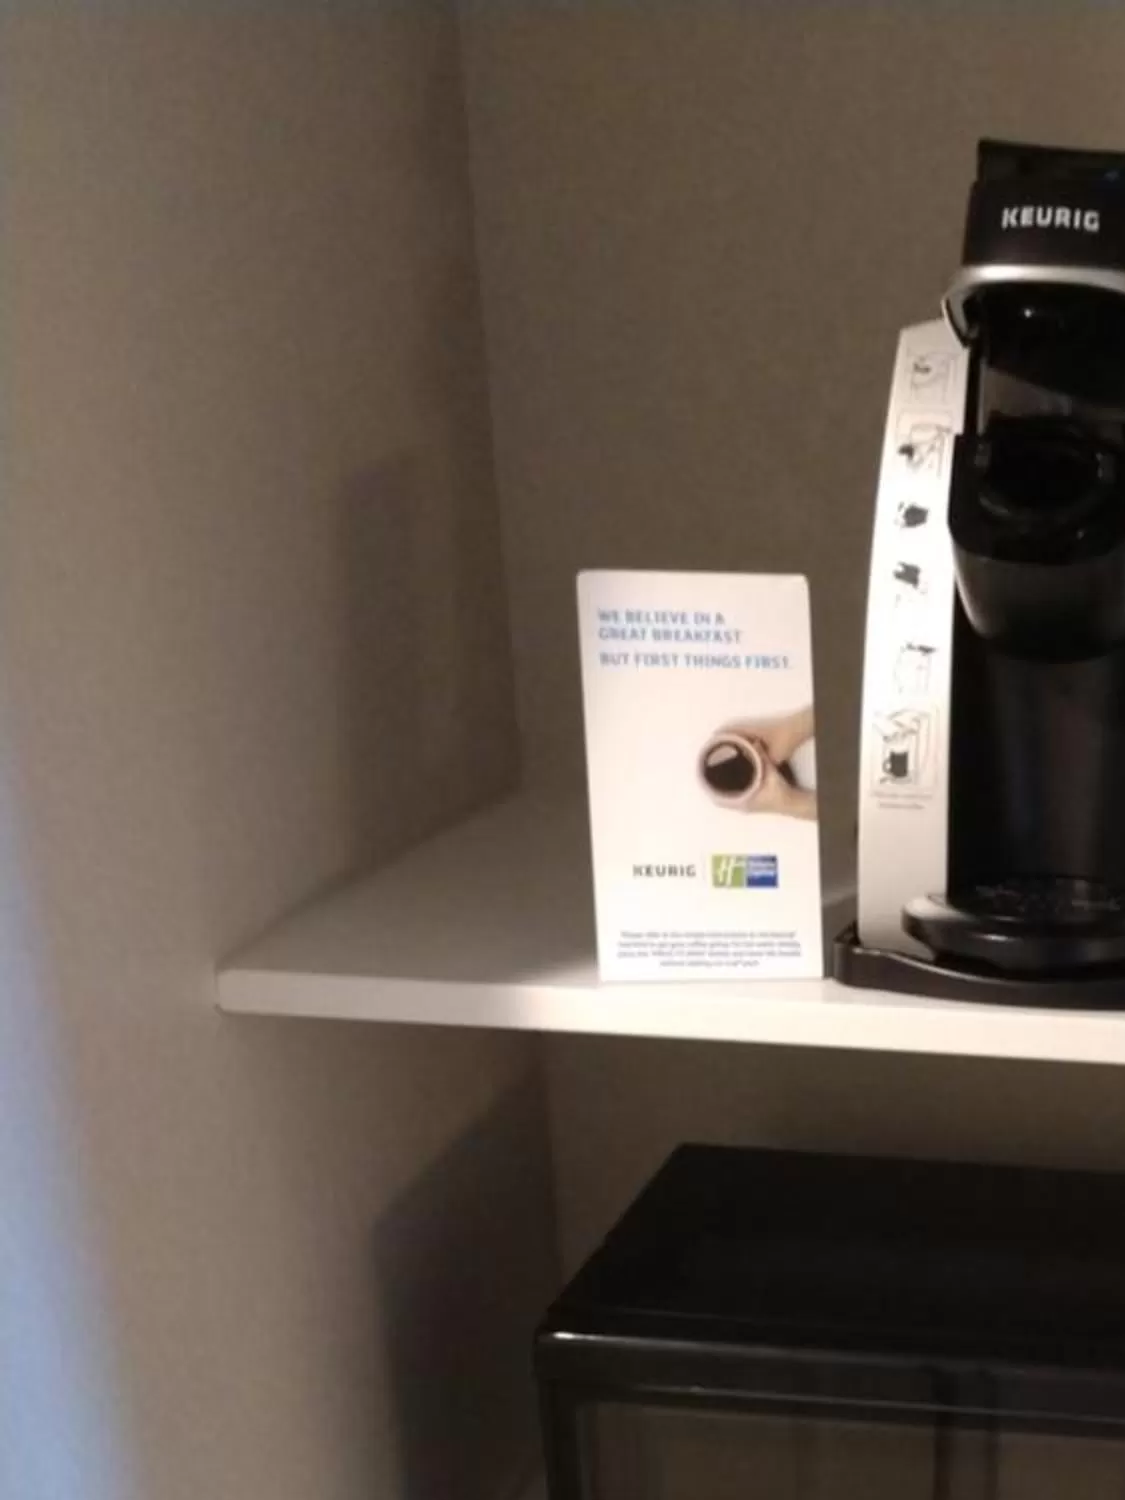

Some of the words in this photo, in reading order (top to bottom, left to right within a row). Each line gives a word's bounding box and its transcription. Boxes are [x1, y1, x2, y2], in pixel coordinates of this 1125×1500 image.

[1002, 205, 1099, 231] KEURIG
[597, 610, 618, 623] WE
[625, 611, 686, 624] BELIEVE
[694, 612, 711, 624] IN
[715, 612, 725, 624] A
[598, 628, 647, 640] GREAT
[652, 629, 742, 643] BREAKFAST
[600, 652, 629, 666] BUT
[634, 652, 679, 667] FIRST
[685, 654, 741, 668] THINGS
[632, 864, 697, 877] KEURIG
